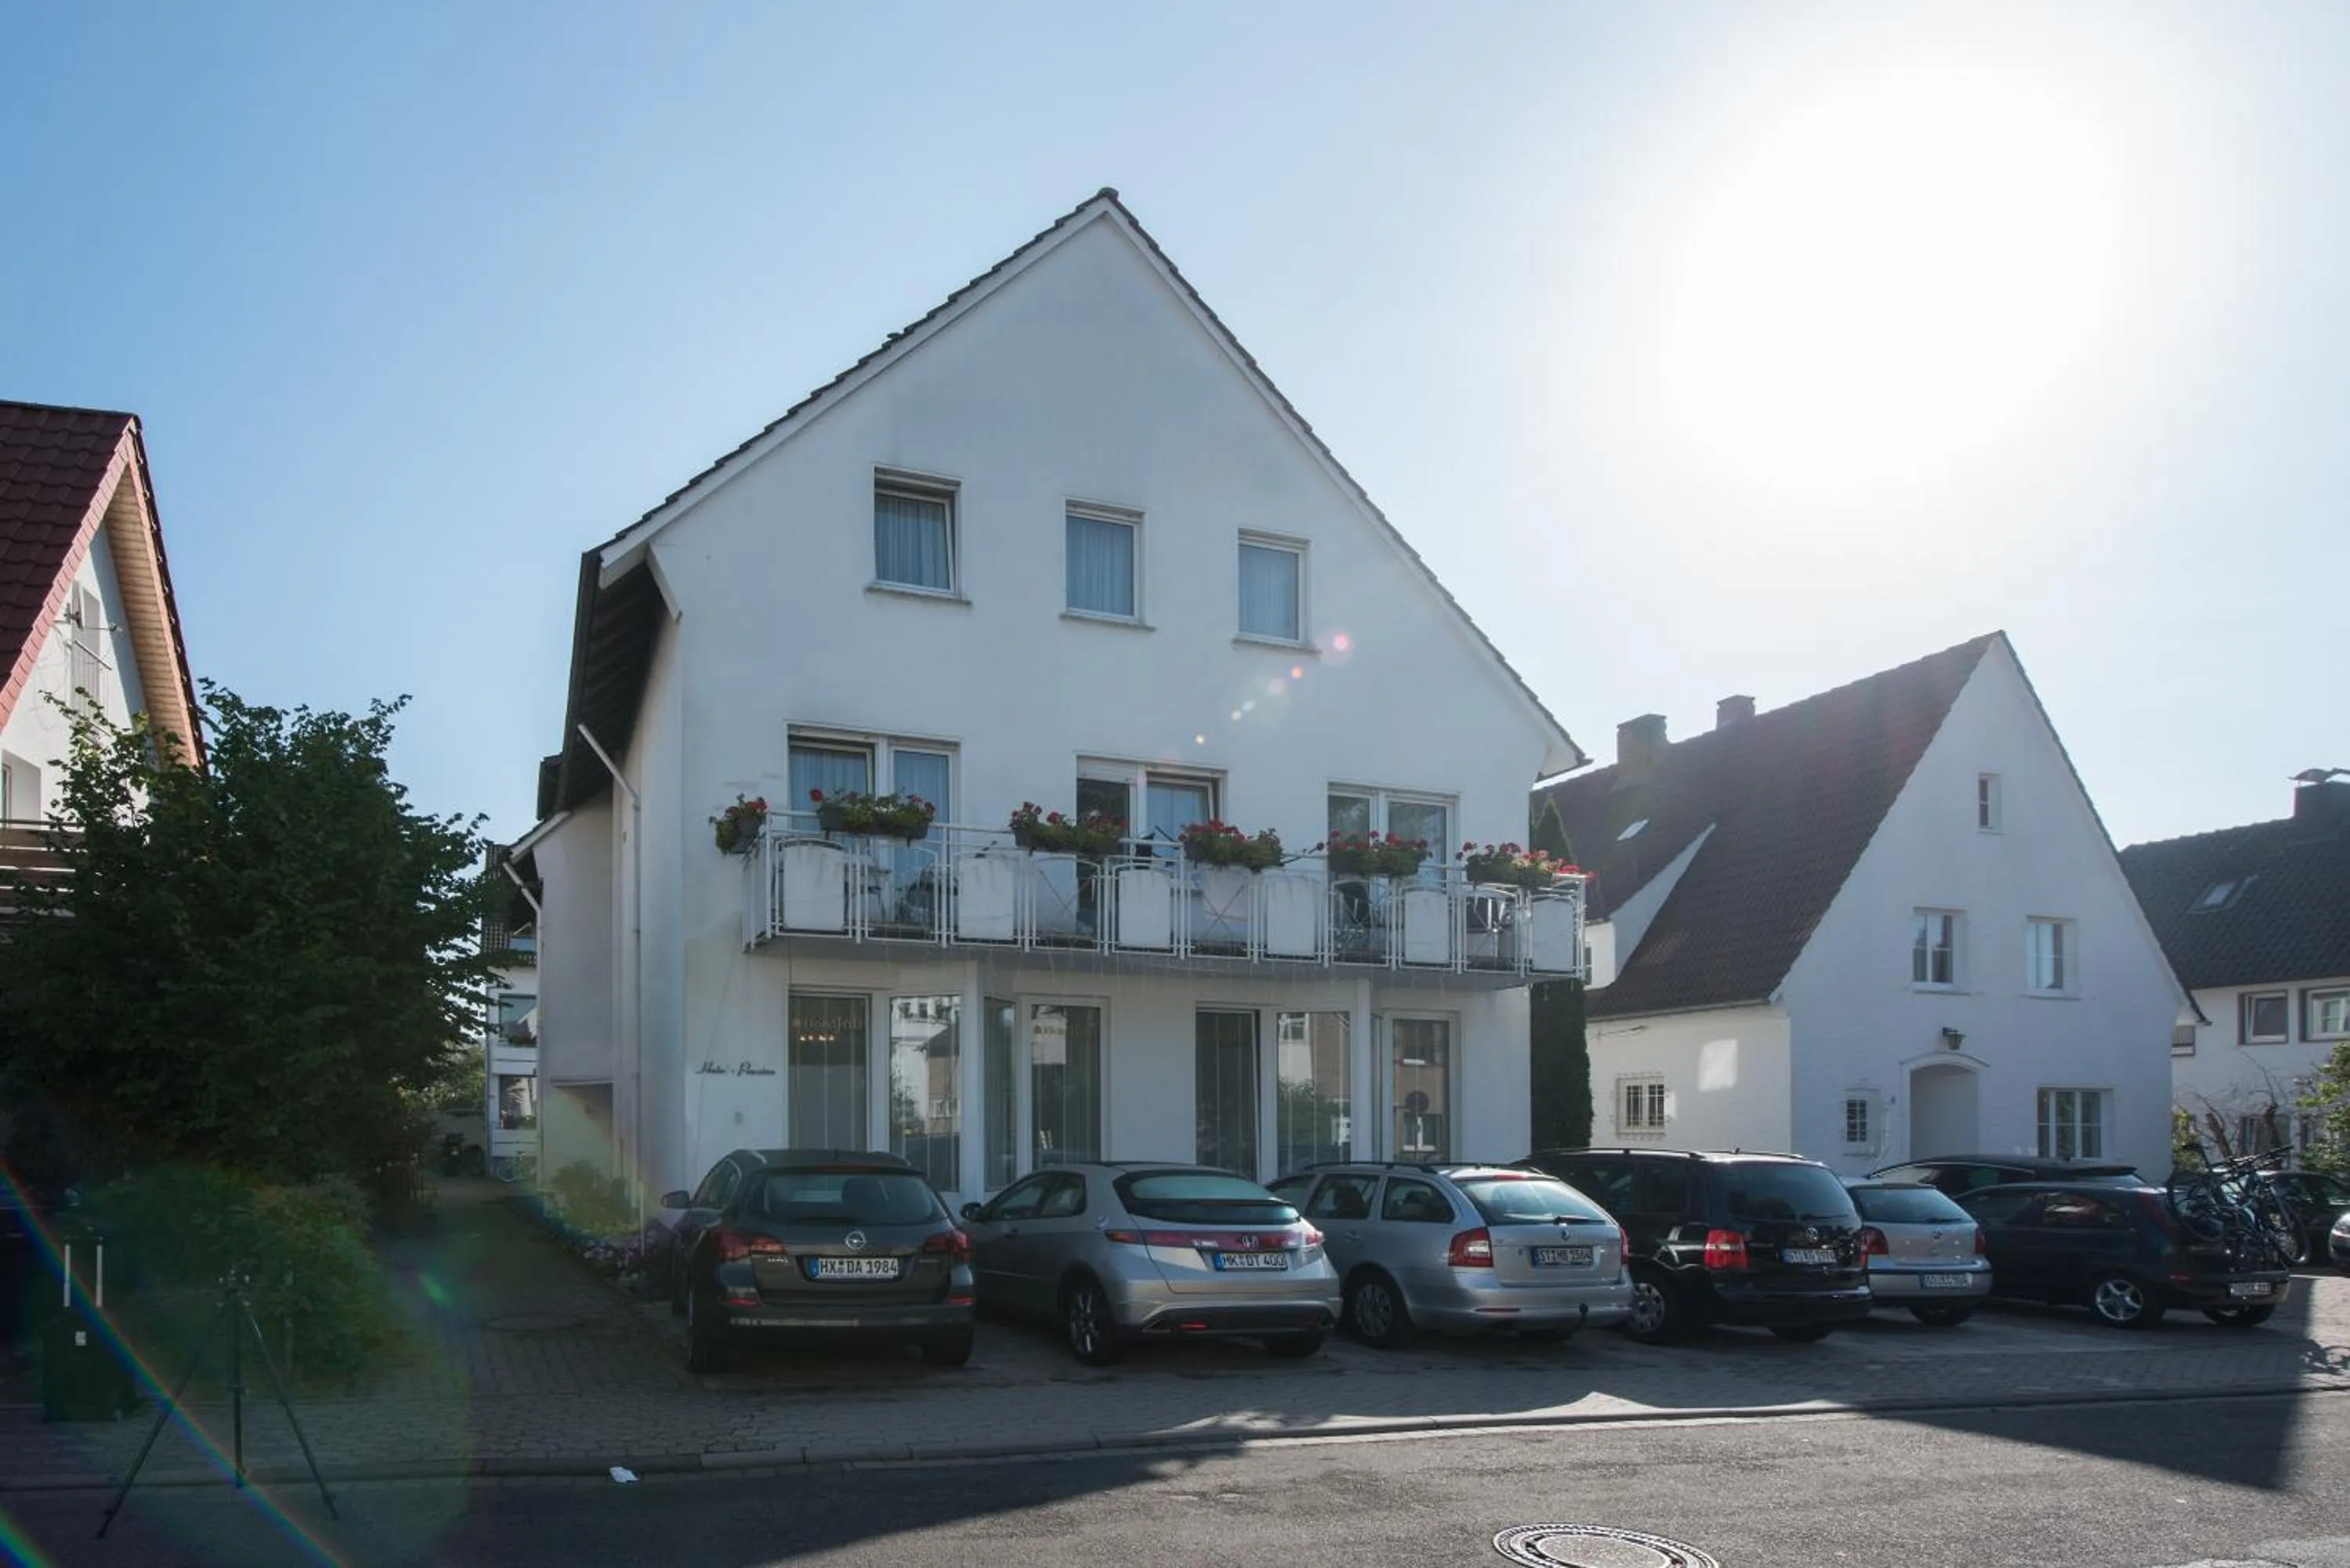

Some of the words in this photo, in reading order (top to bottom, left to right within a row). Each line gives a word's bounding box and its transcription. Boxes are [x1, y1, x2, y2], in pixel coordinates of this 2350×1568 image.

[820, 1260, 836, 1274] HX
[847, 1260, 862, 1274] DA
[866, 1260, 897, 1274] 1984
